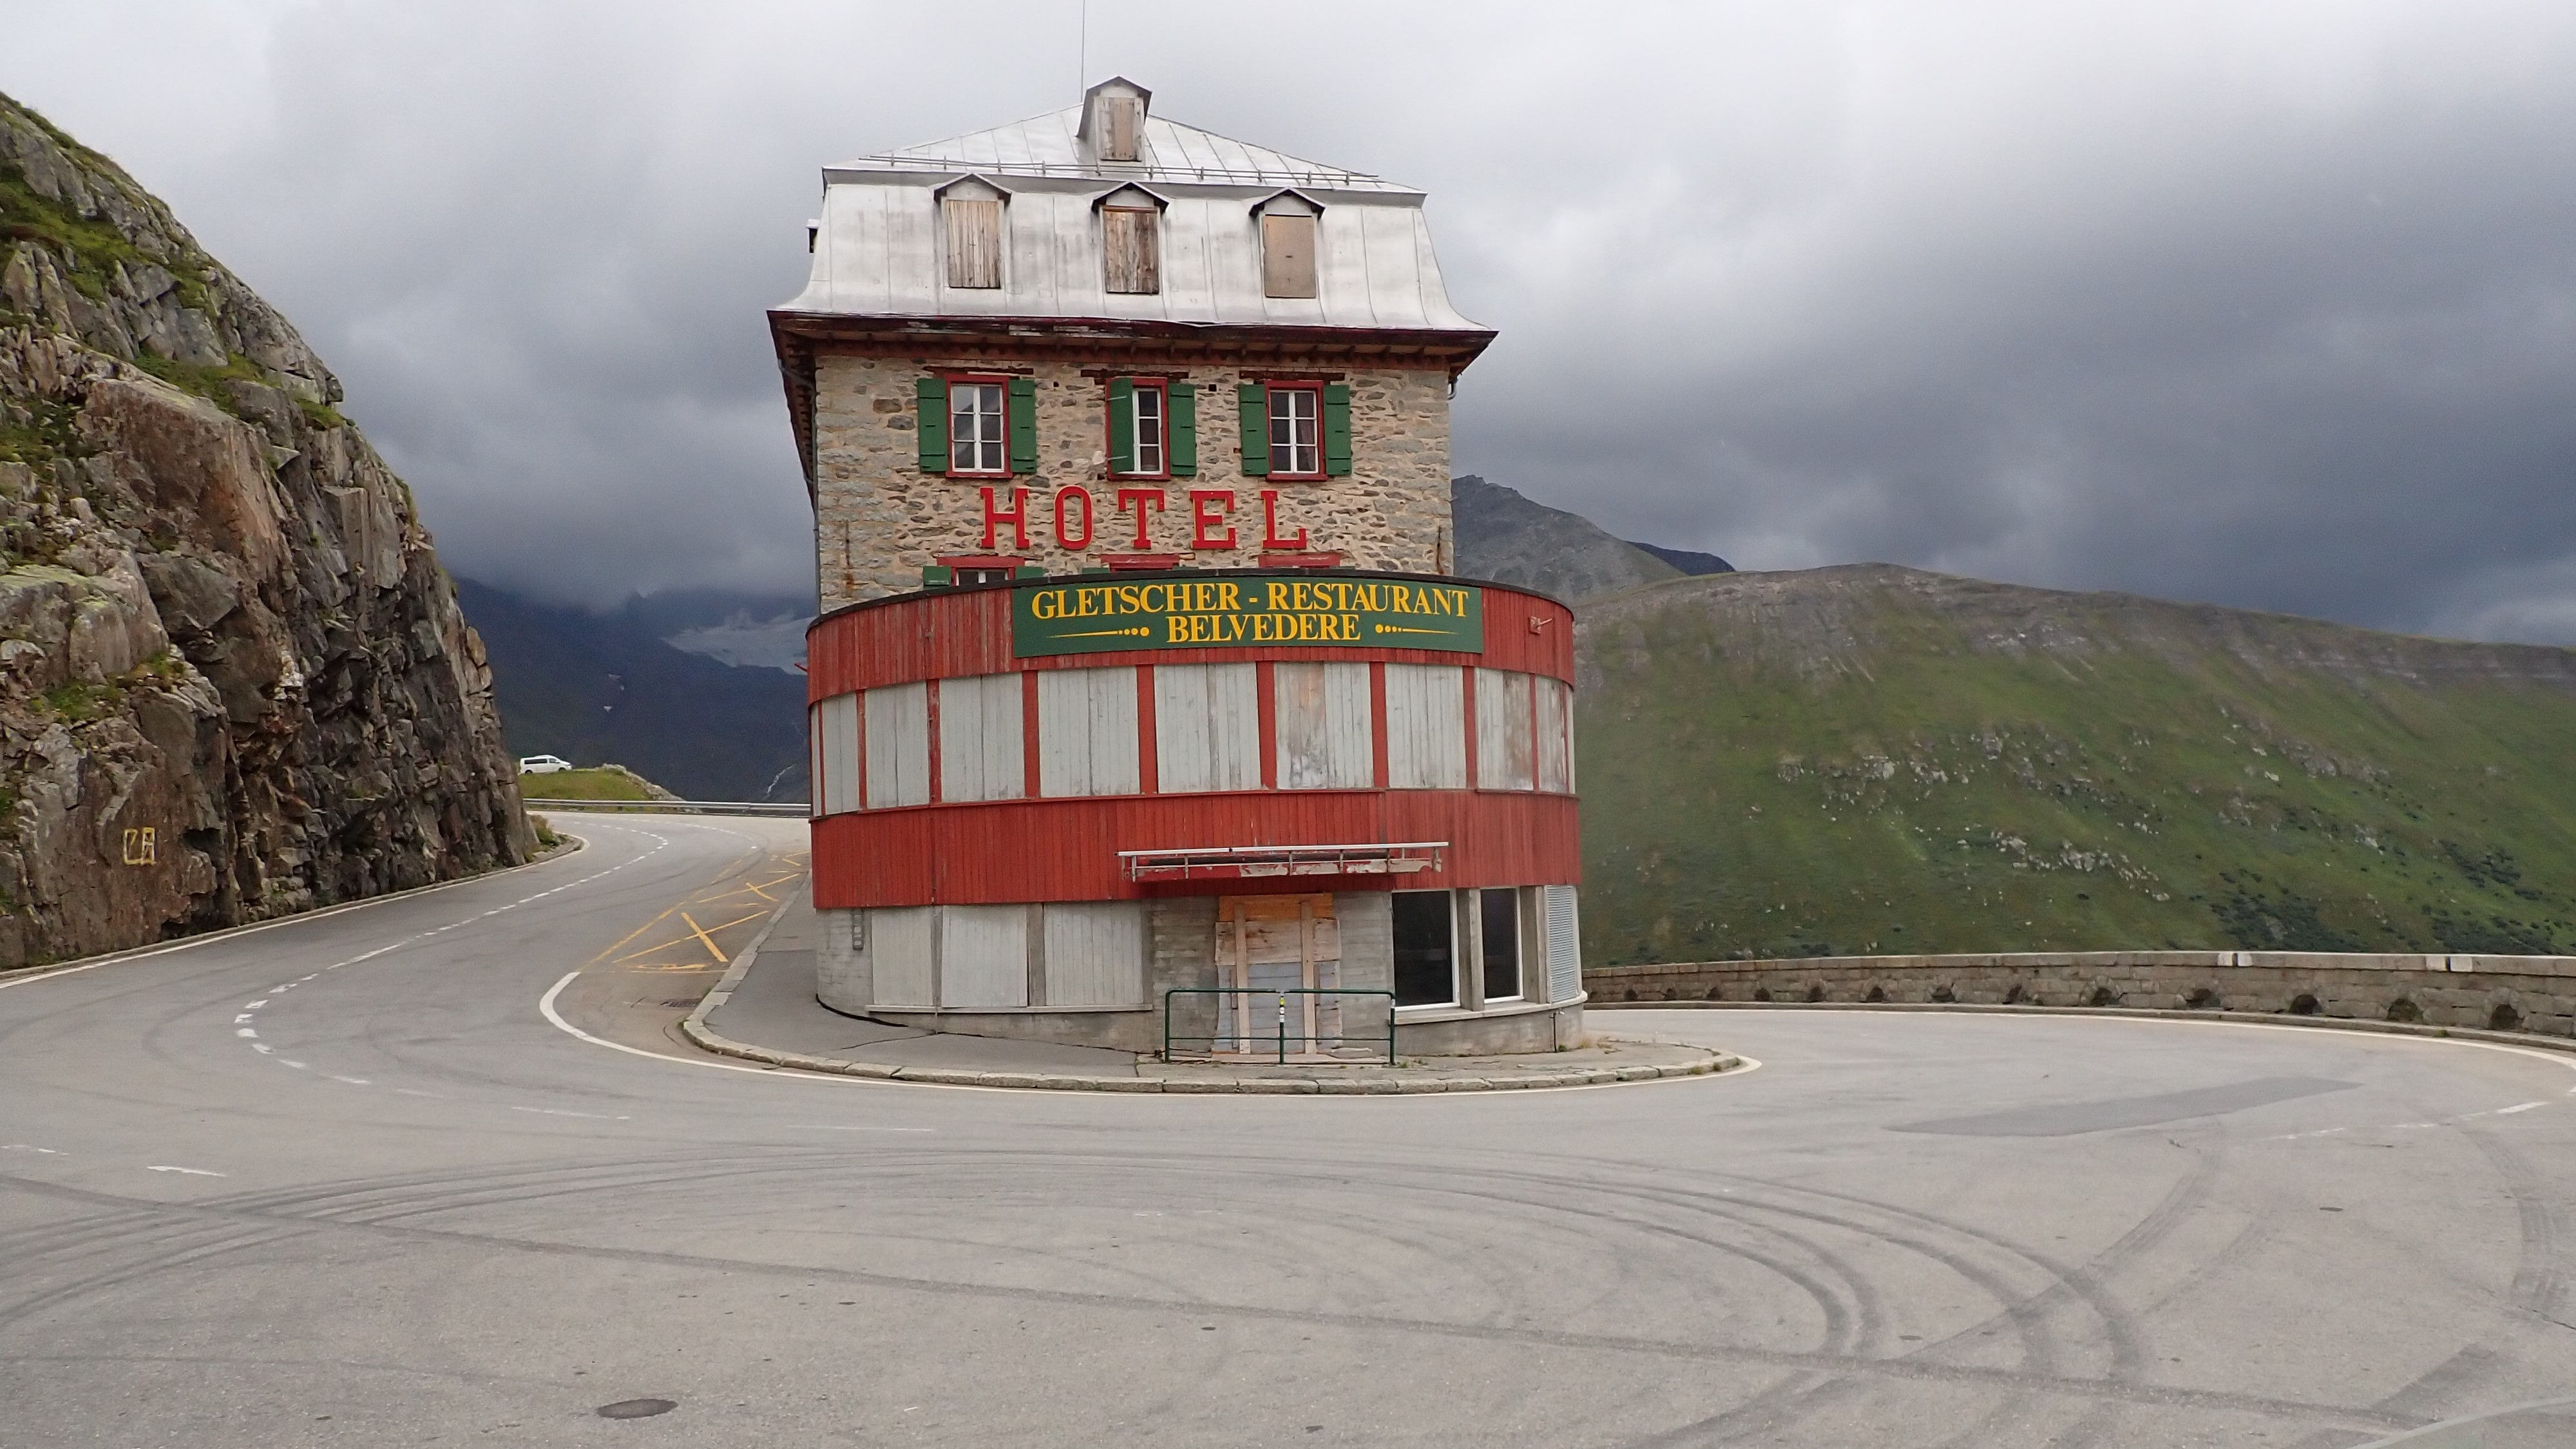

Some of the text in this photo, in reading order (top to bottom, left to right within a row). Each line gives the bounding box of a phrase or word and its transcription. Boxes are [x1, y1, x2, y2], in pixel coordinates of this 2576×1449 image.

[980, 485, 1307, 550] HOTEL
[1031, 582, 1242, 620] GLETSCHER
[1266, 582, 1469, 618] RESTAURANT
[1167, 613, 1362, 643] BELVEDERE
